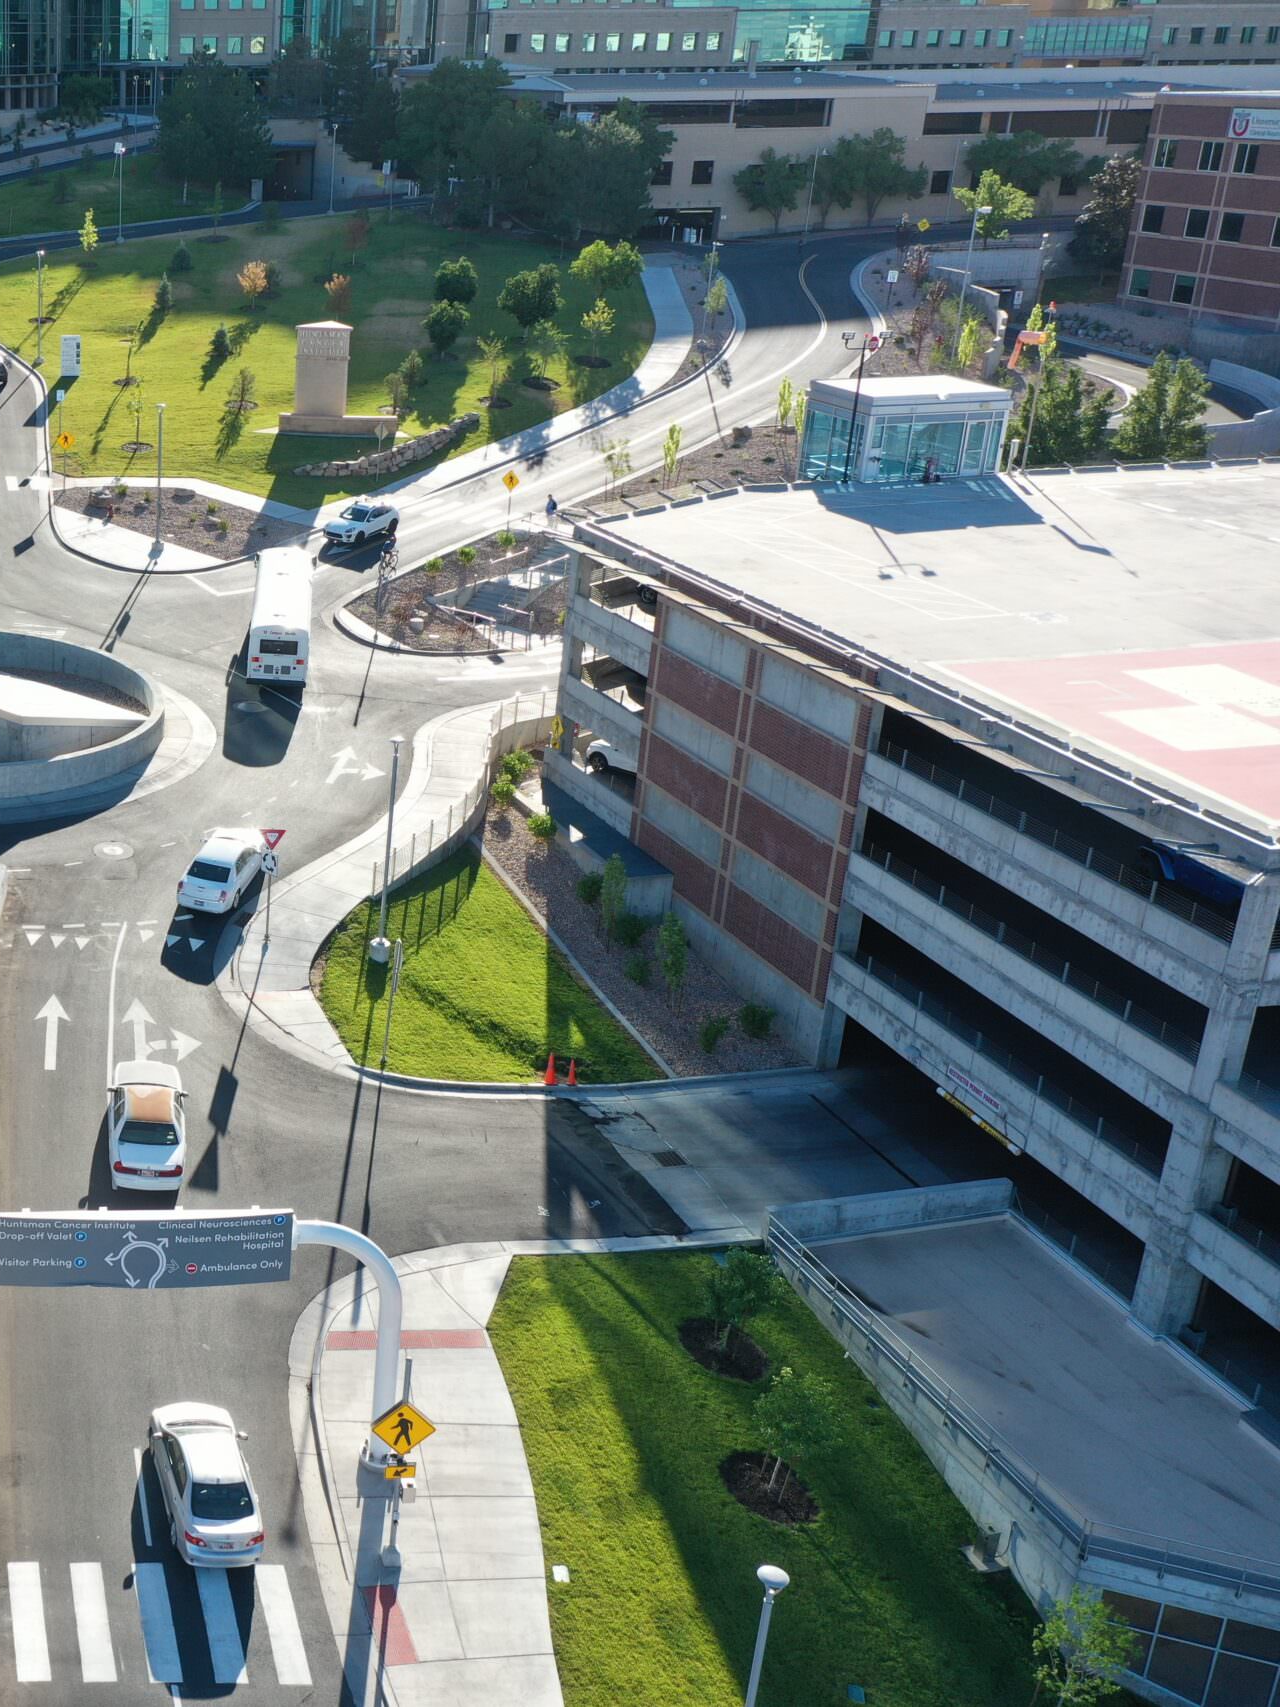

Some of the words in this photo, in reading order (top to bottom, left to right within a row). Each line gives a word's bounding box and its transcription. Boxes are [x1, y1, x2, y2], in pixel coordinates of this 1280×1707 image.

[54, 1221, 91, 1229] Cancer
[94, 1221, 136, 1230] Institute
[158, 1221, 196, 1230] Clinical
[199, 1219, 272, 1229] Neurosciences
[0, 1231, 45, 1241] Drop-off
[47, 1232, 73, 1240] Valet
[175, 1235, 212, 1244] Neilsen
[214, 1231, 285, 1242] Rehabilitation
[242, 1240, 284, 1250] Hospital
[33, 1258, 72, 1269] Parking
[200, 1262, 258, 1272] Ambulance
[260, 1260, 283, 1269] Only
